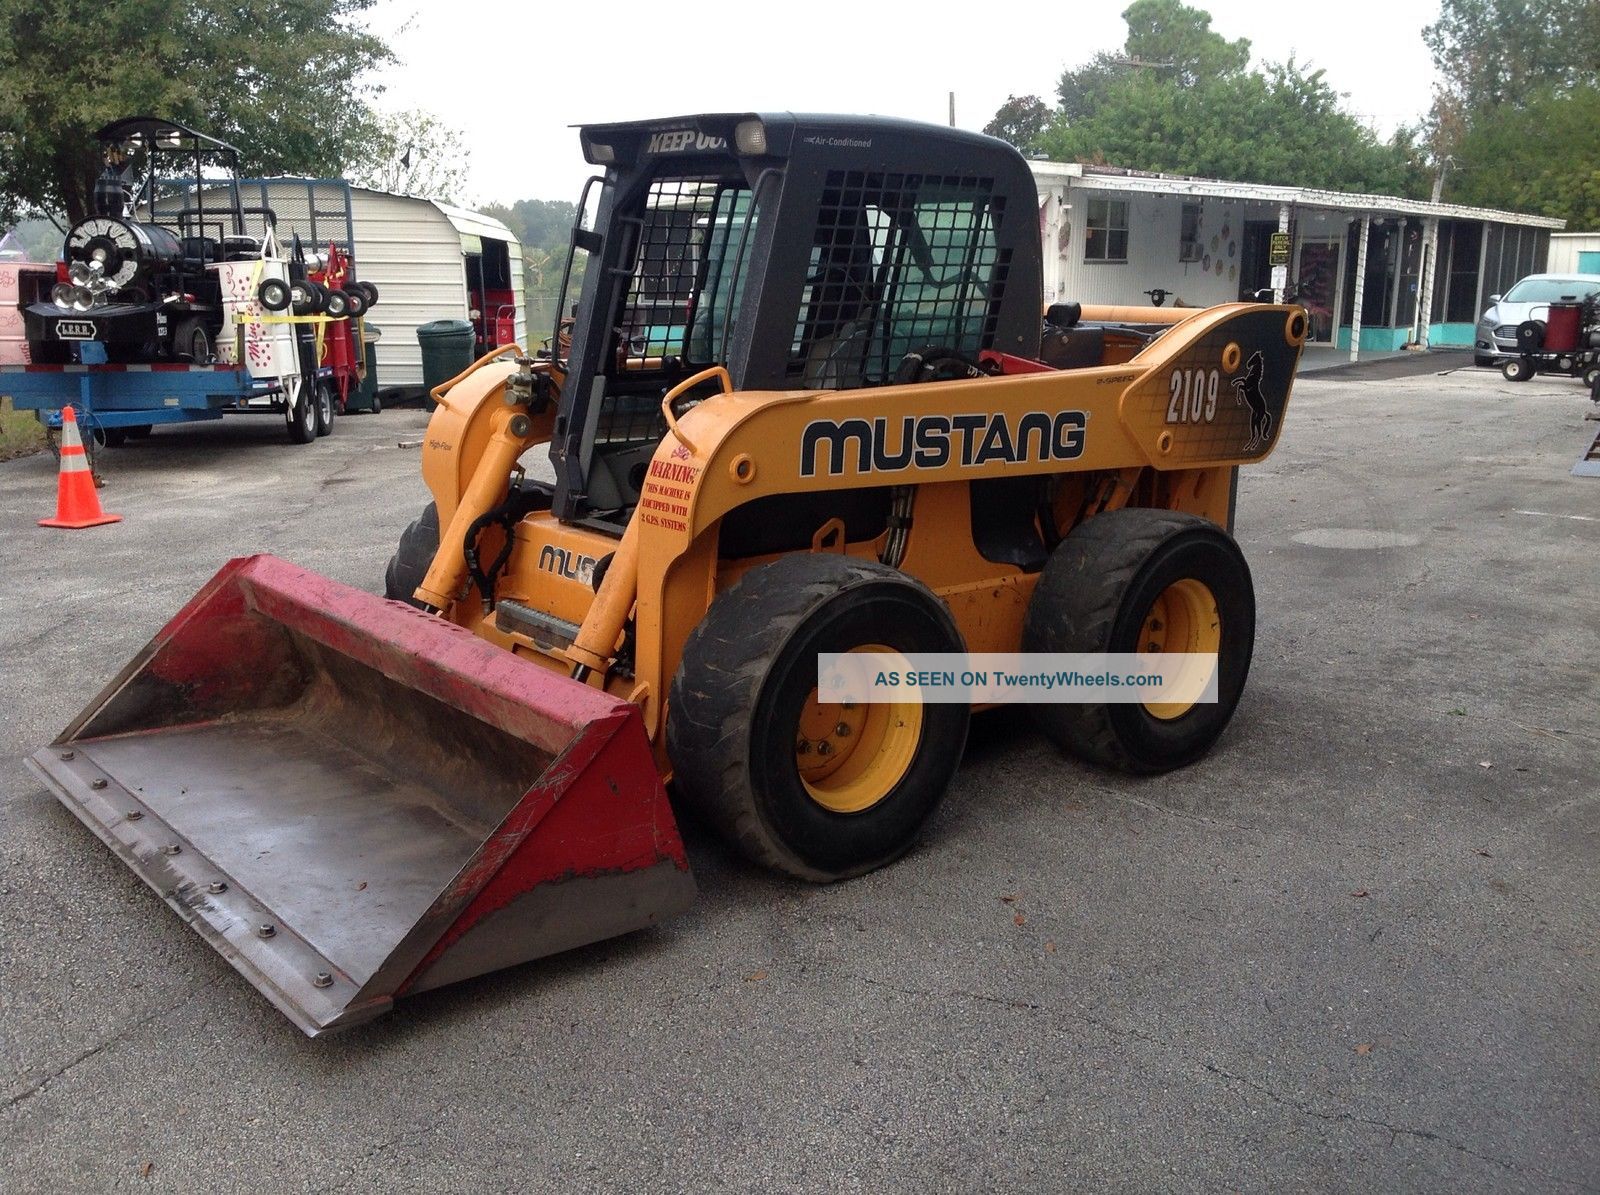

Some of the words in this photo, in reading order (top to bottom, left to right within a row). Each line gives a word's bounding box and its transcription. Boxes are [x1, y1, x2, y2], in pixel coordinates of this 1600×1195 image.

[648, 131, 695, 152] KEEP
[696, 131, 727, 150] OU
[815, 136, 872, 148] Air-Conditioned
[1165, 368, 1220, 423] 2109
[800, 410, 1086, 478] MUSTANG
[659, 485, 684, 500] MACHINE
[684, 490, 692, 500] IS
[642, 498, 671, 512] EQUIPPED
[671, 504, 688, 517] WITH
[660, 517, 687, 532] SYSTEMS
